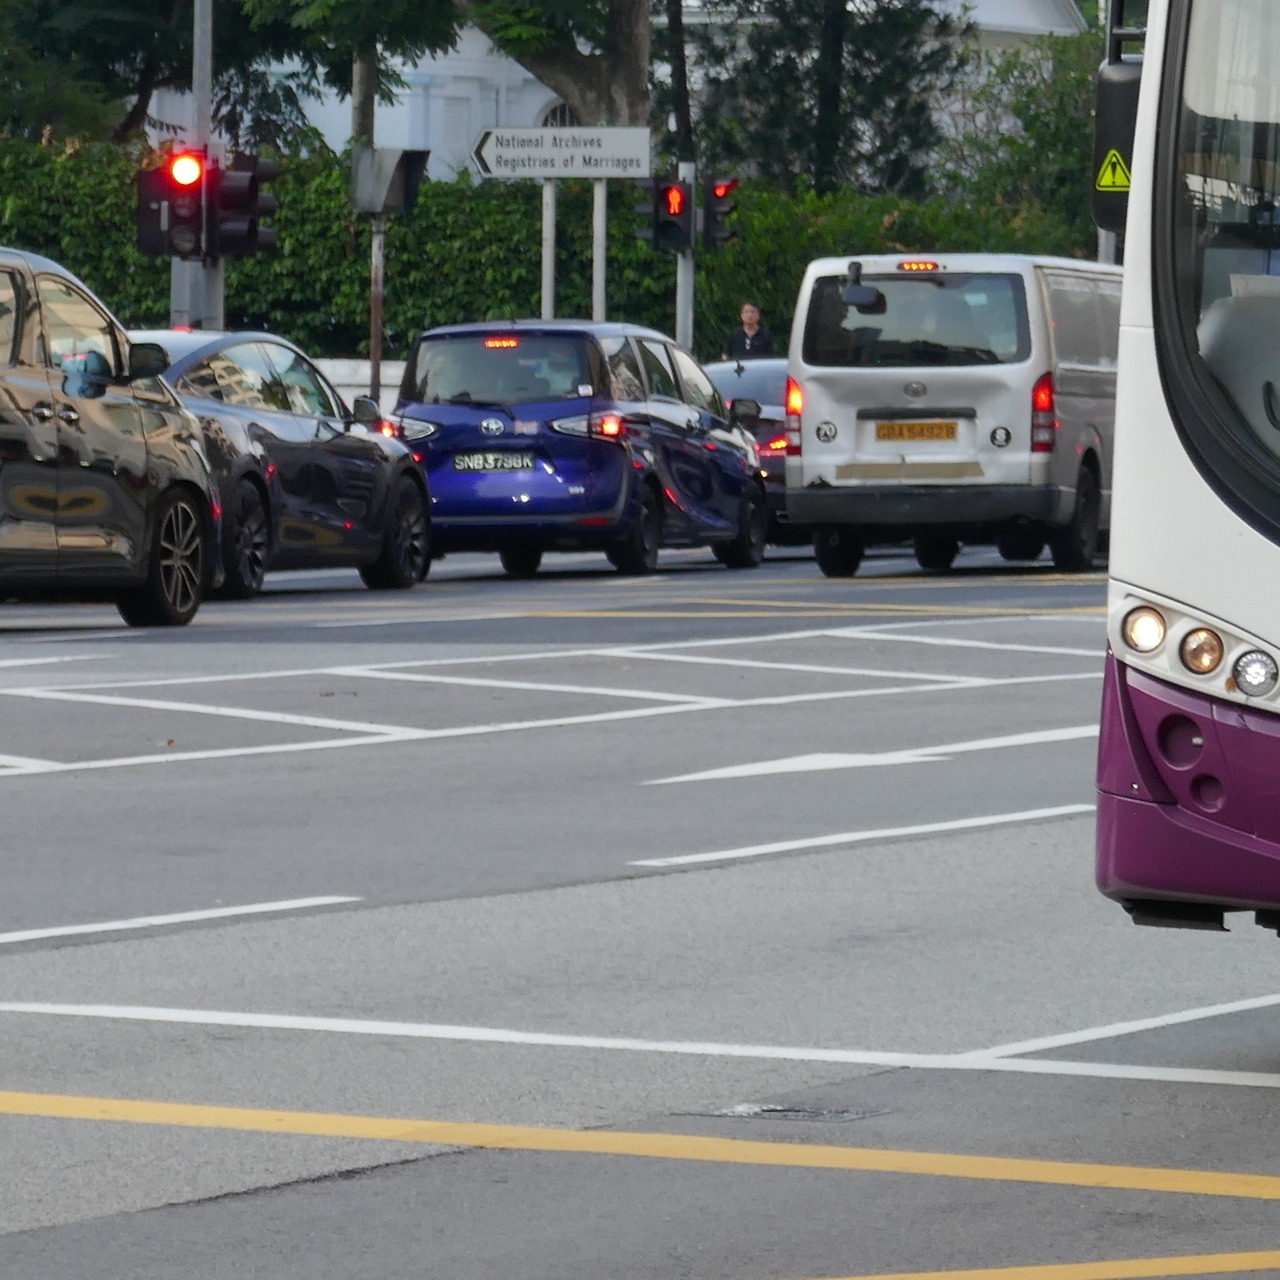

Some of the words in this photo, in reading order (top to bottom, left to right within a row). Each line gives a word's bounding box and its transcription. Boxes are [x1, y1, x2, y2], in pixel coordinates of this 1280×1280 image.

[495, 135, 544, 149] National
[552, 135, 602, 149] Archives
[495, 154, 556, 172] Registries
[562, 154, 575, 168] of
[582, 155, 641, 172] Marriages
